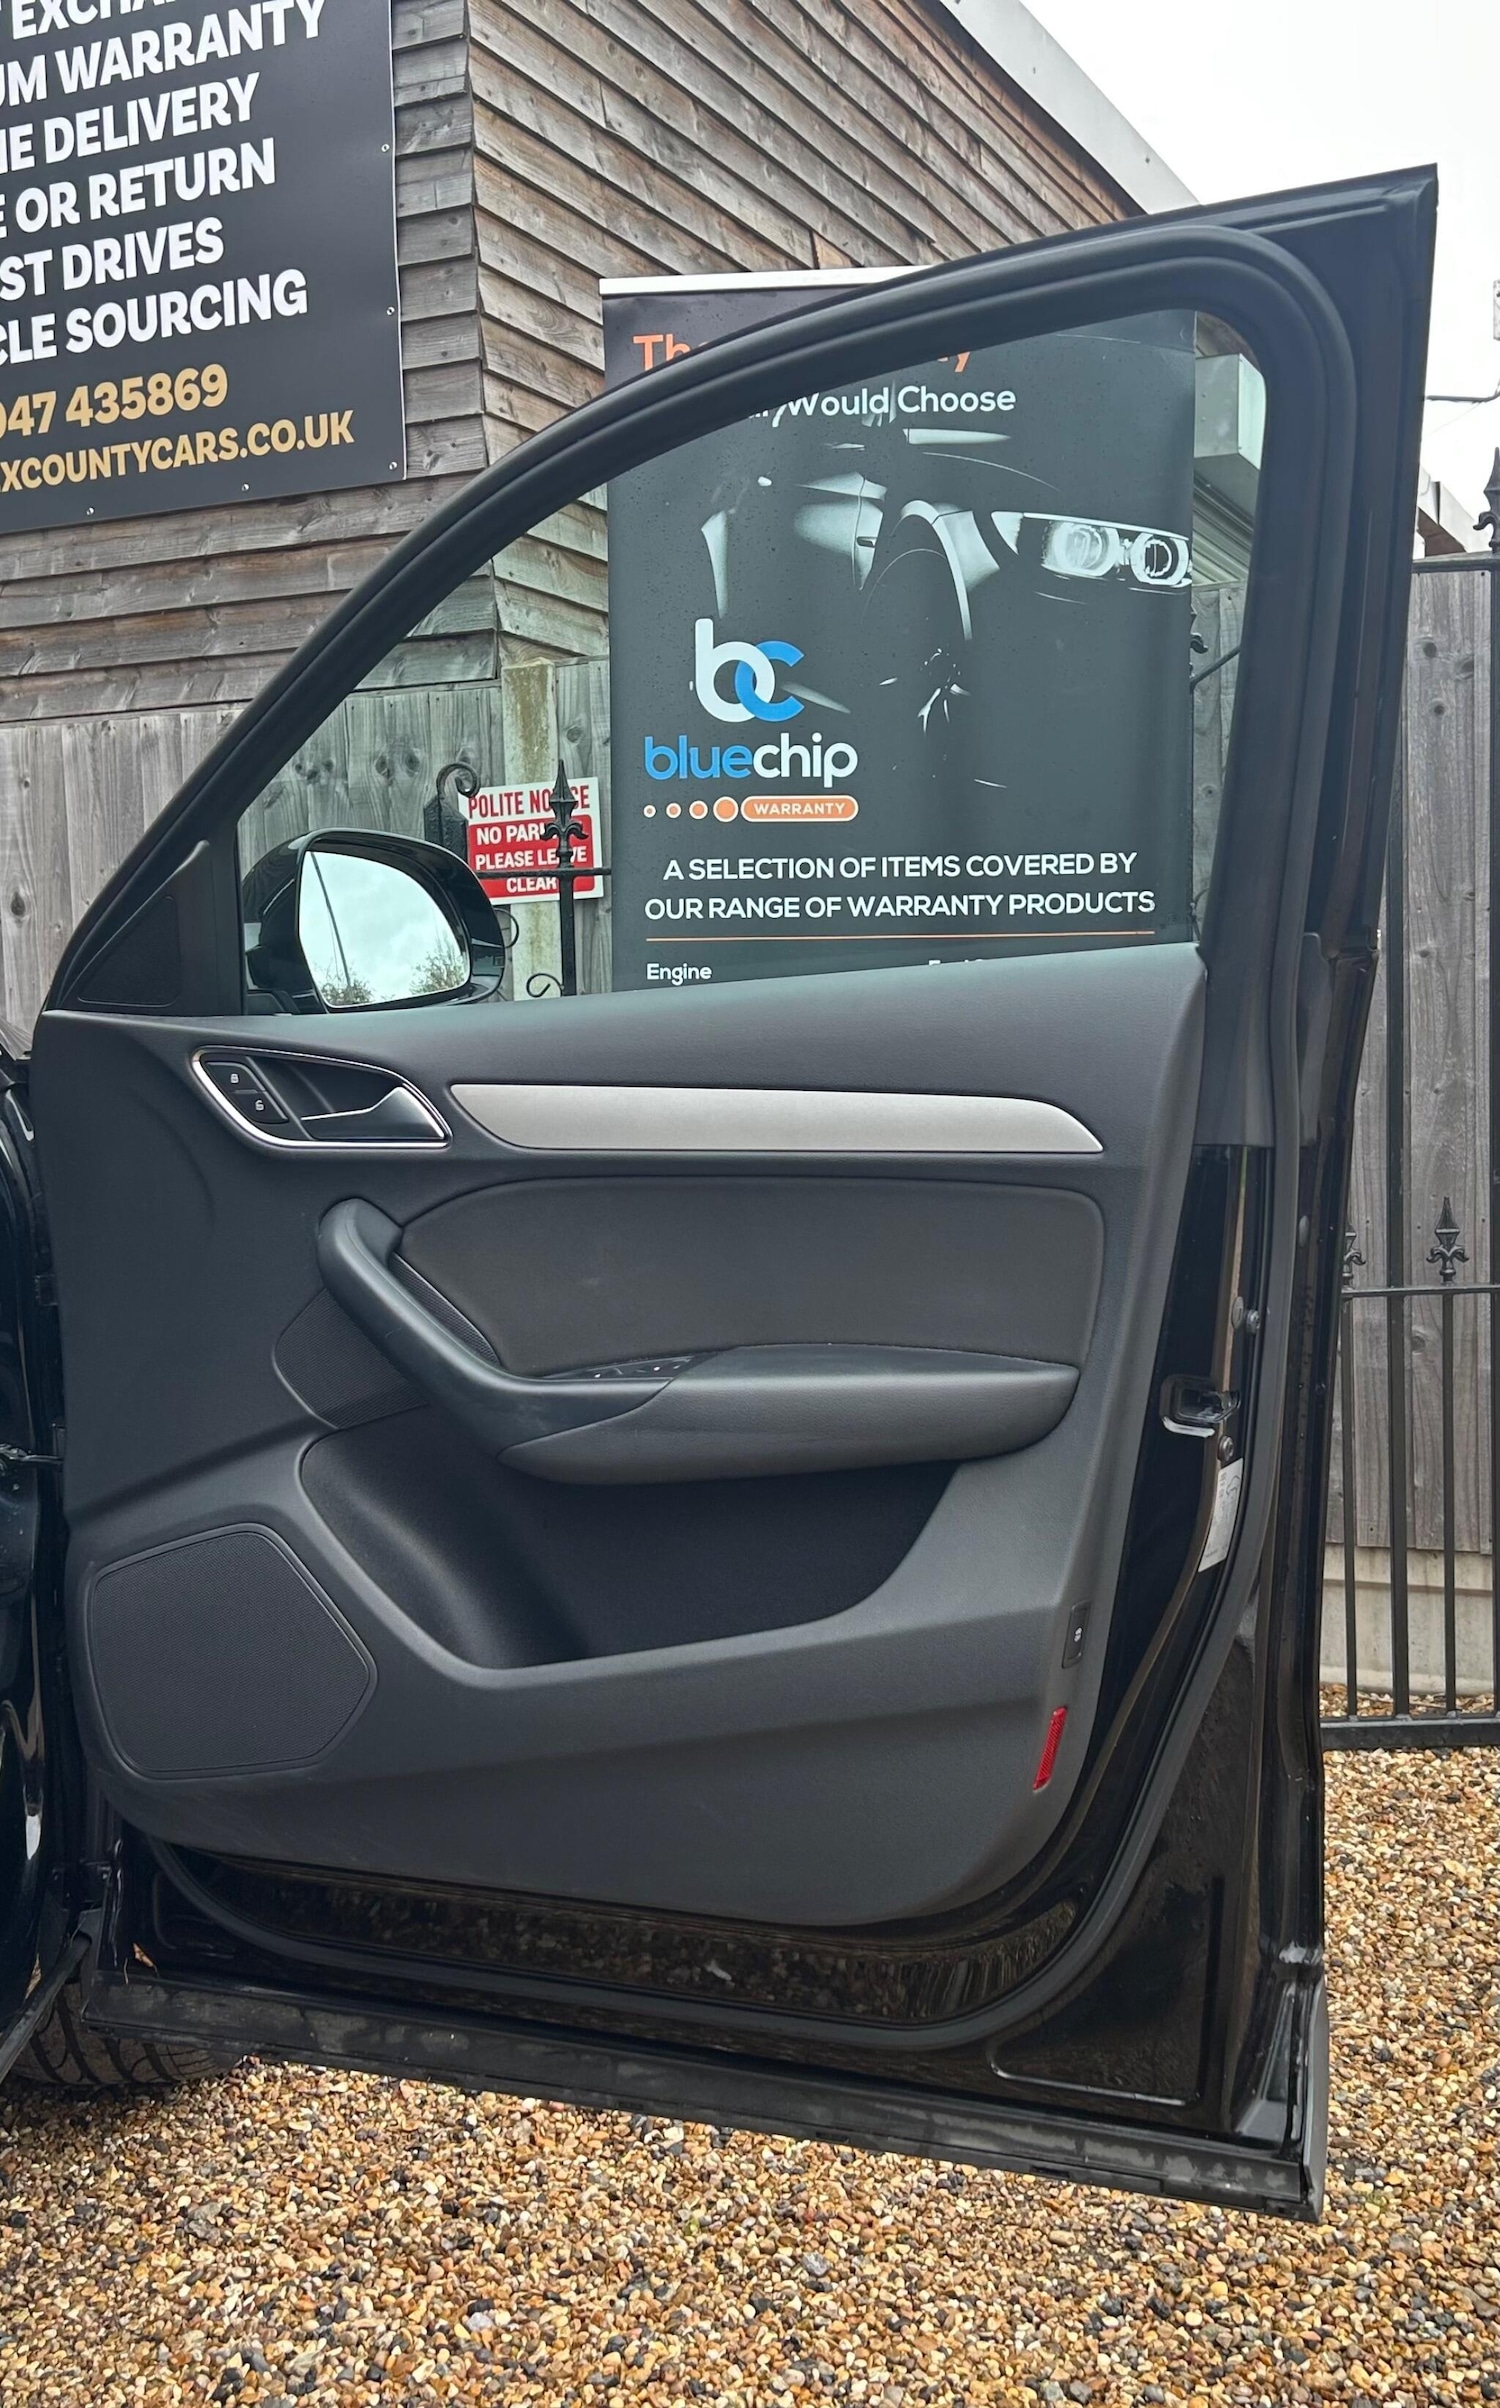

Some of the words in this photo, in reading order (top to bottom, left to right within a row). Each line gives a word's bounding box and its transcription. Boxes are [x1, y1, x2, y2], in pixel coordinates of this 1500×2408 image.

[55, 0, 325, 94] WARRANTY
[44, 72, 260, 164] DELIVERY
[15, 181, 80, 233] OR
[88, 137, 275, 220] RETURN
[62, 217, 224, 290] DRIVES
[65, 268, 307, 354] SOURCING
[0, 391, 56, 440] 47
[65, 363, 228, 428] 435869
[898, 385, 1017, 413] Choose
[0, 410, 355, 493] XCOUNTYCARS.CO.UK
[644, 732, 858, 787] bluechip
[468, 792, 524, 819] POLITE
[753, 801, 846, 817] WARRANTY
[476, 826, 502, 846] NO
[475, 851, 535, 870] PLEASE
[663, 859, 684, 880] A
[688, 858, 834, 880] SELECTION
[839, 857, 876, 878] OF
[881, 855, 960, 878] ITEMS
[966, 854, 1093, 877] COVERED
[1100, 852, 1138, 874] BY
[644, 896, 703, 920] OUR
[708, 896, 800, 919] RANGE
[805, 895, 842, 918] OF
[846, 894, 1004, 917] WARRANTY
[1009, 891, 1156, 915] PRODUCTS
[646, 963, 712, 986] Engine
